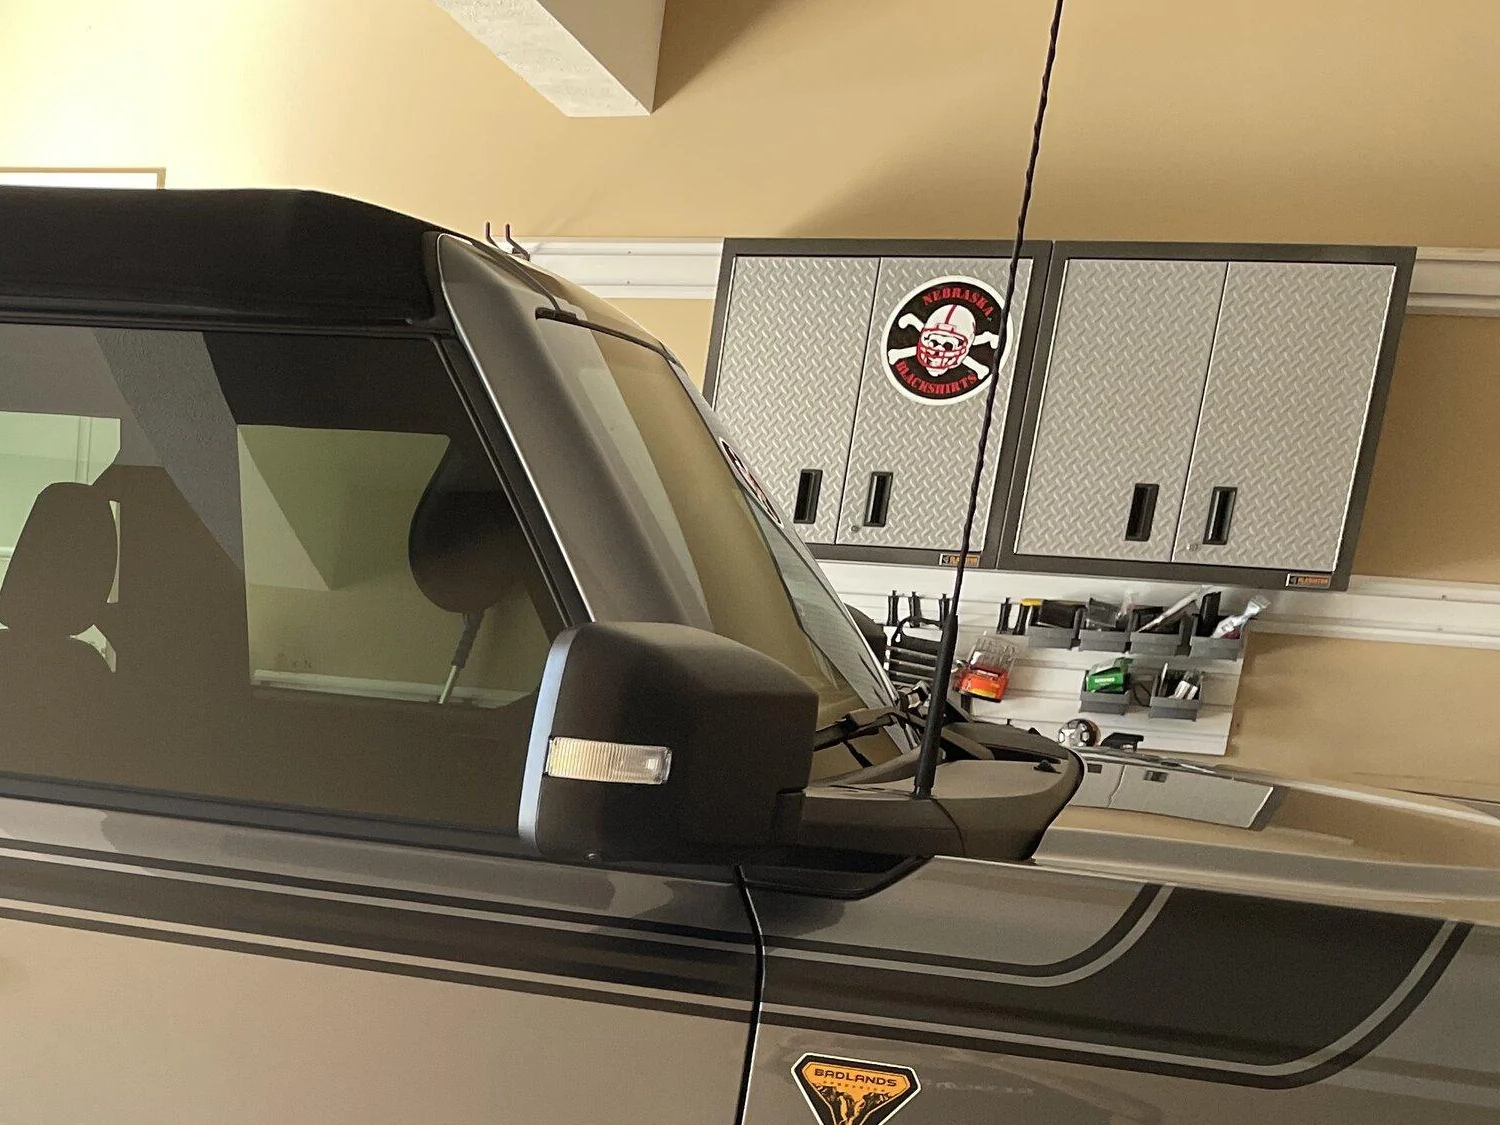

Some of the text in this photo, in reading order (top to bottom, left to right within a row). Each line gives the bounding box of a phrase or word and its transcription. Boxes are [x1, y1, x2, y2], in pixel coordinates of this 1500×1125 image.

[922, 288, 994, 317] NEBRASKA
[895, 361, 979, 395] BLACKSHIRTS
[814, 1068, 897, 1087] BADLANDS
